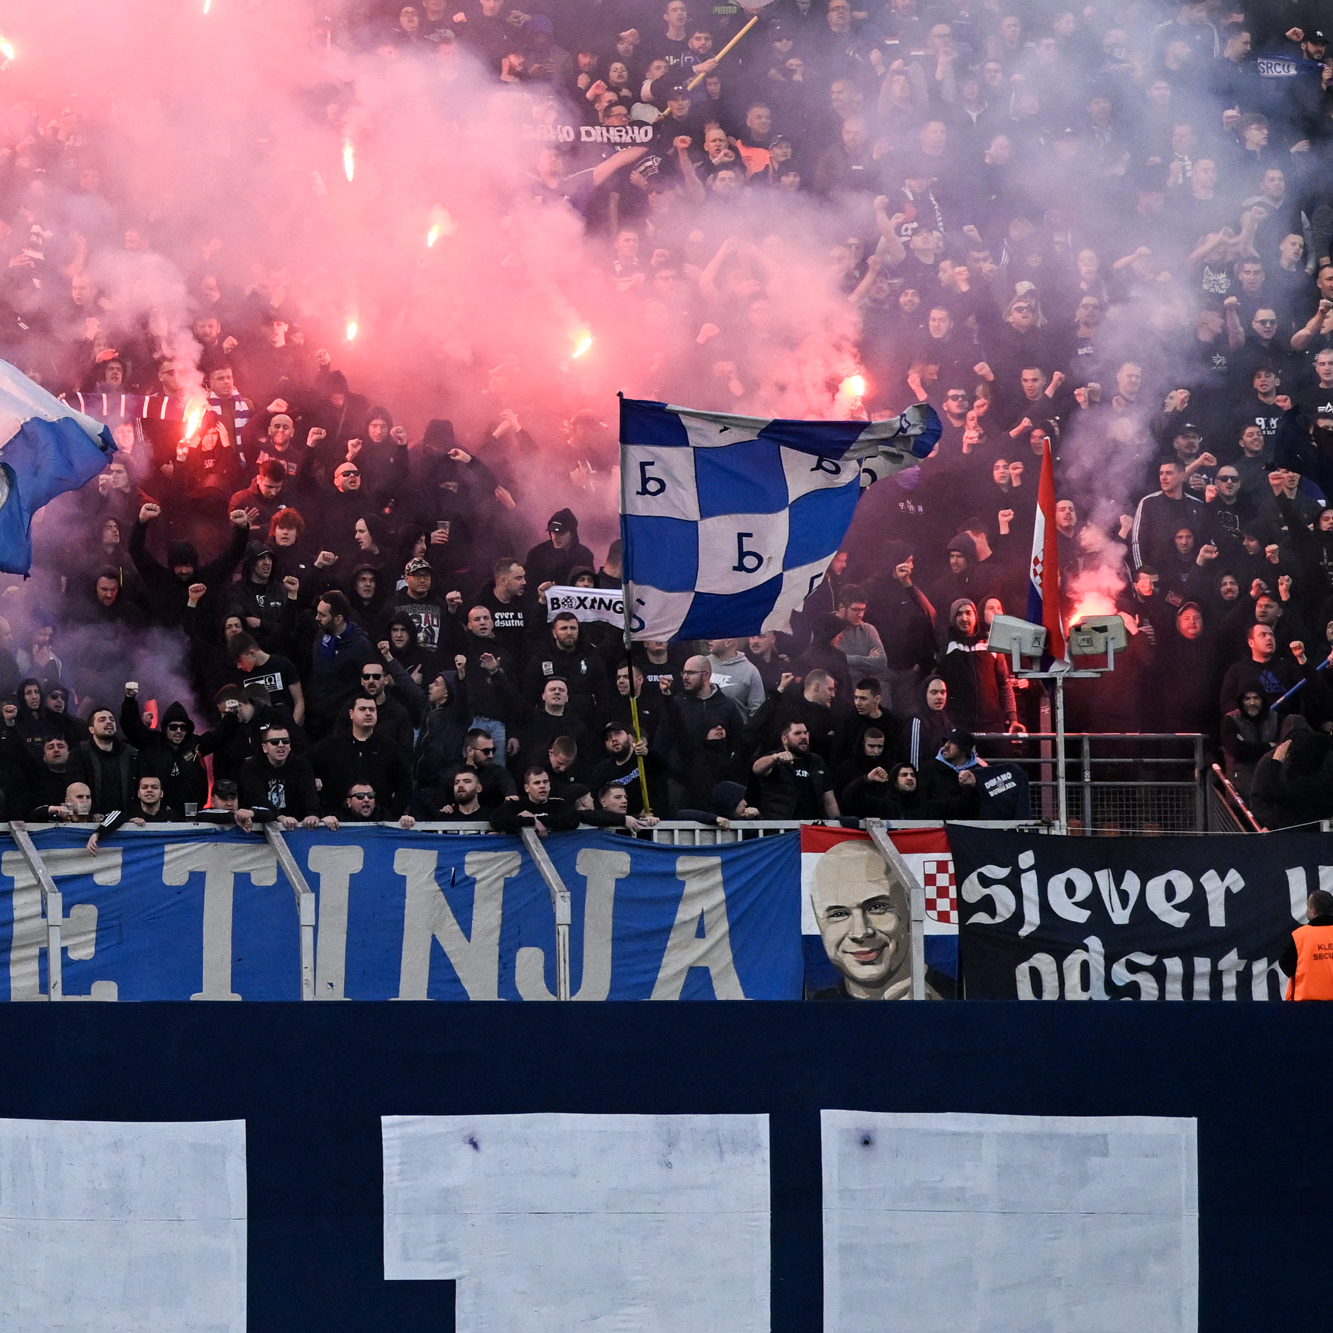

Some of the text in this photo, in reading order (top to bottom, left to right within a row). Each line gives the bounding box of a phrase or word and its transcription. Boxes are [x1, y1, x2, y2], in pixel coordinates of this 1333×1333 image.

[494, 611, 515, 620] ever
[710, 673, 732, 685] NIKE
[961, 849, 1246, 939] sjever
[1317, 943, 1333, 952] KLE
[1312, 952, 1333, 961] SECU
[1014, 935, 1290, 1002] odsutn
